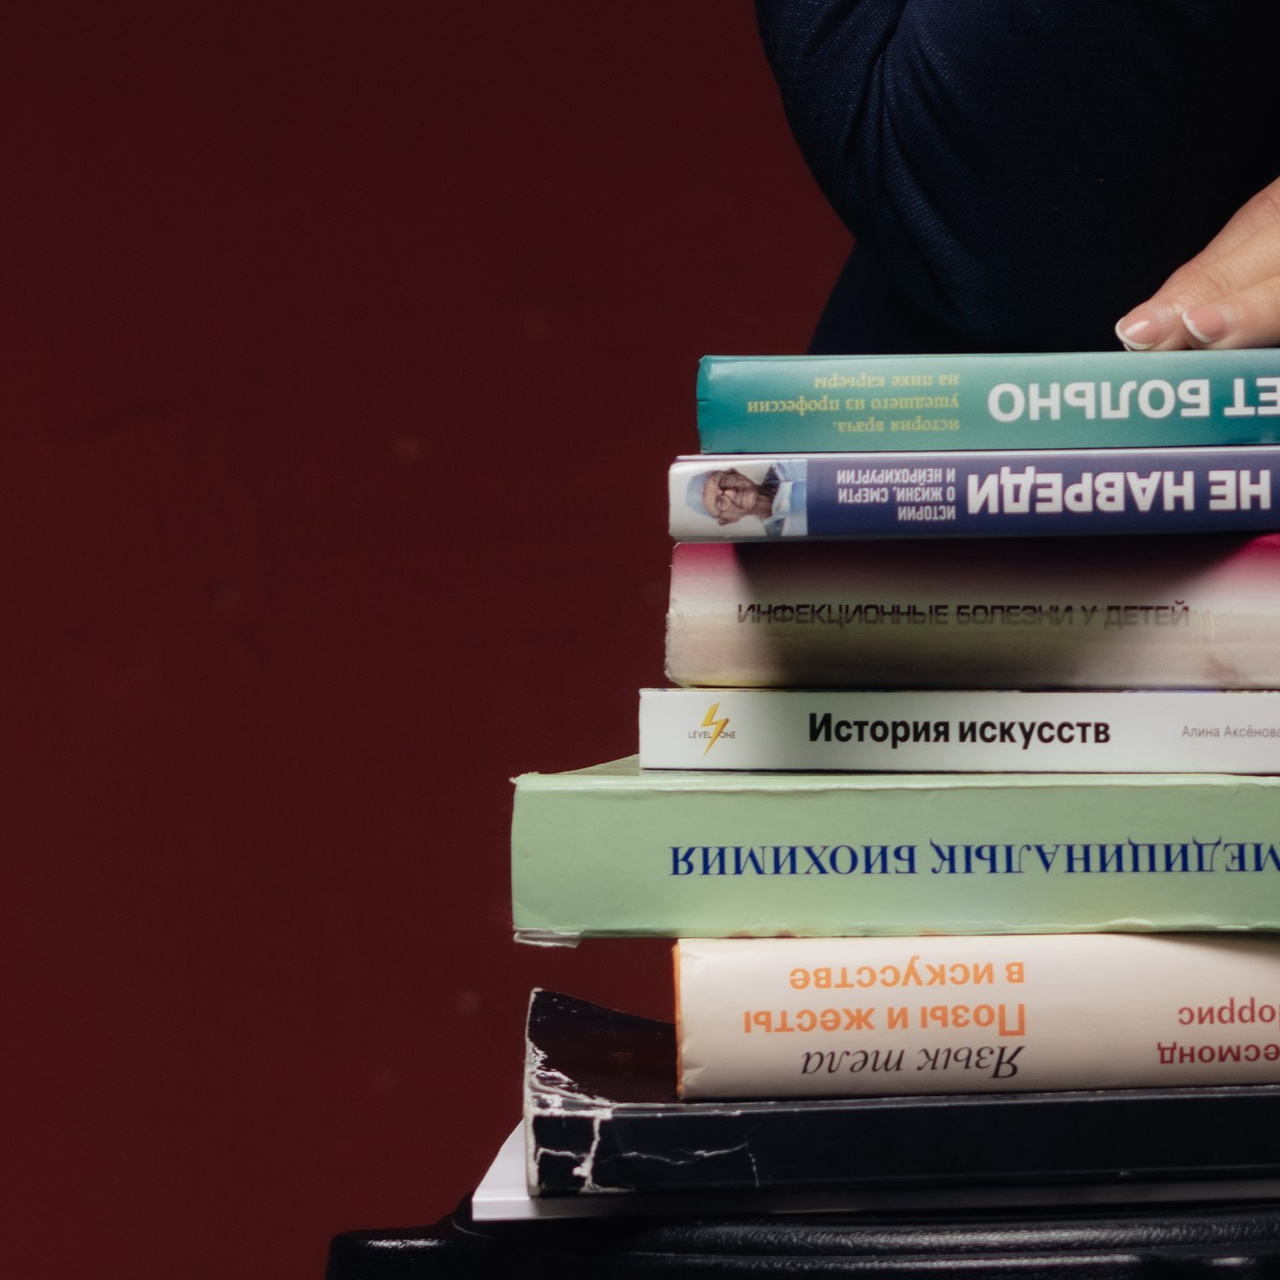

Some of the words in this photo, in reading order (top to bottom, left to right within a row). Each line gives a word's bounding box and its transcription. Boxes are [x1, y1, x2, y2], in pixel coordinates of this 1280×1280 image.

[814, 373, 886, 389] карьеры
[891, 374, 933, 386] пике
[938, 374, 960, 386] на
[747, 396, 840, 415] профессии
[846, 398, 866, 410] из
[871, 396, 960, 411] ушедшего
[988, 379, 1211, 422] БОЛЬНО
[890, 417, 960, 432] история
[837, 469, 943, 487] НЕЙРОХИРУРГИИ
[946, 469, 956, 483] И
[838, 488, 888, 503] СМЕРТИ
[895, 485, 943, 501] ЖИЗНИ,
[946, 487, 956, 501] О
[967, 466, 1195, 514] НАВРЕДИ
[1208, 470, 1271, 511] НЕ
[897, 506, 956, 520] ИСТОРИИ
[737, 603, 949, 626] ИНФЕКЦИОННЫЕ
[956, 603, 1074, 625] БОЛЕЗНИ
[1080, 604, 1100, 625] У
[1104, 600, 1190, 628] ДЕТЕЙ
[688, 730, 712, 739] LEVEL
[719, 730, 736, 739] ONE
[809, 712, 949, 749] История
[959, 721, 1111, 749] искусств
[1182, 725, 1220, 738] Алина
[670, 845, 917, 876] БИОХИМИЯ
[789, 955, 995, 990] искусстве
[1005, 961, 1025, 983] в
[743, 1008, 875, 1033] жесты
[887, 1007, 908, 1029] и
[921, 1004, 1025, 1036] Позы
[801, 1049, 905, 1074] тела
[917, 1046, 1025, 1079] Язык
